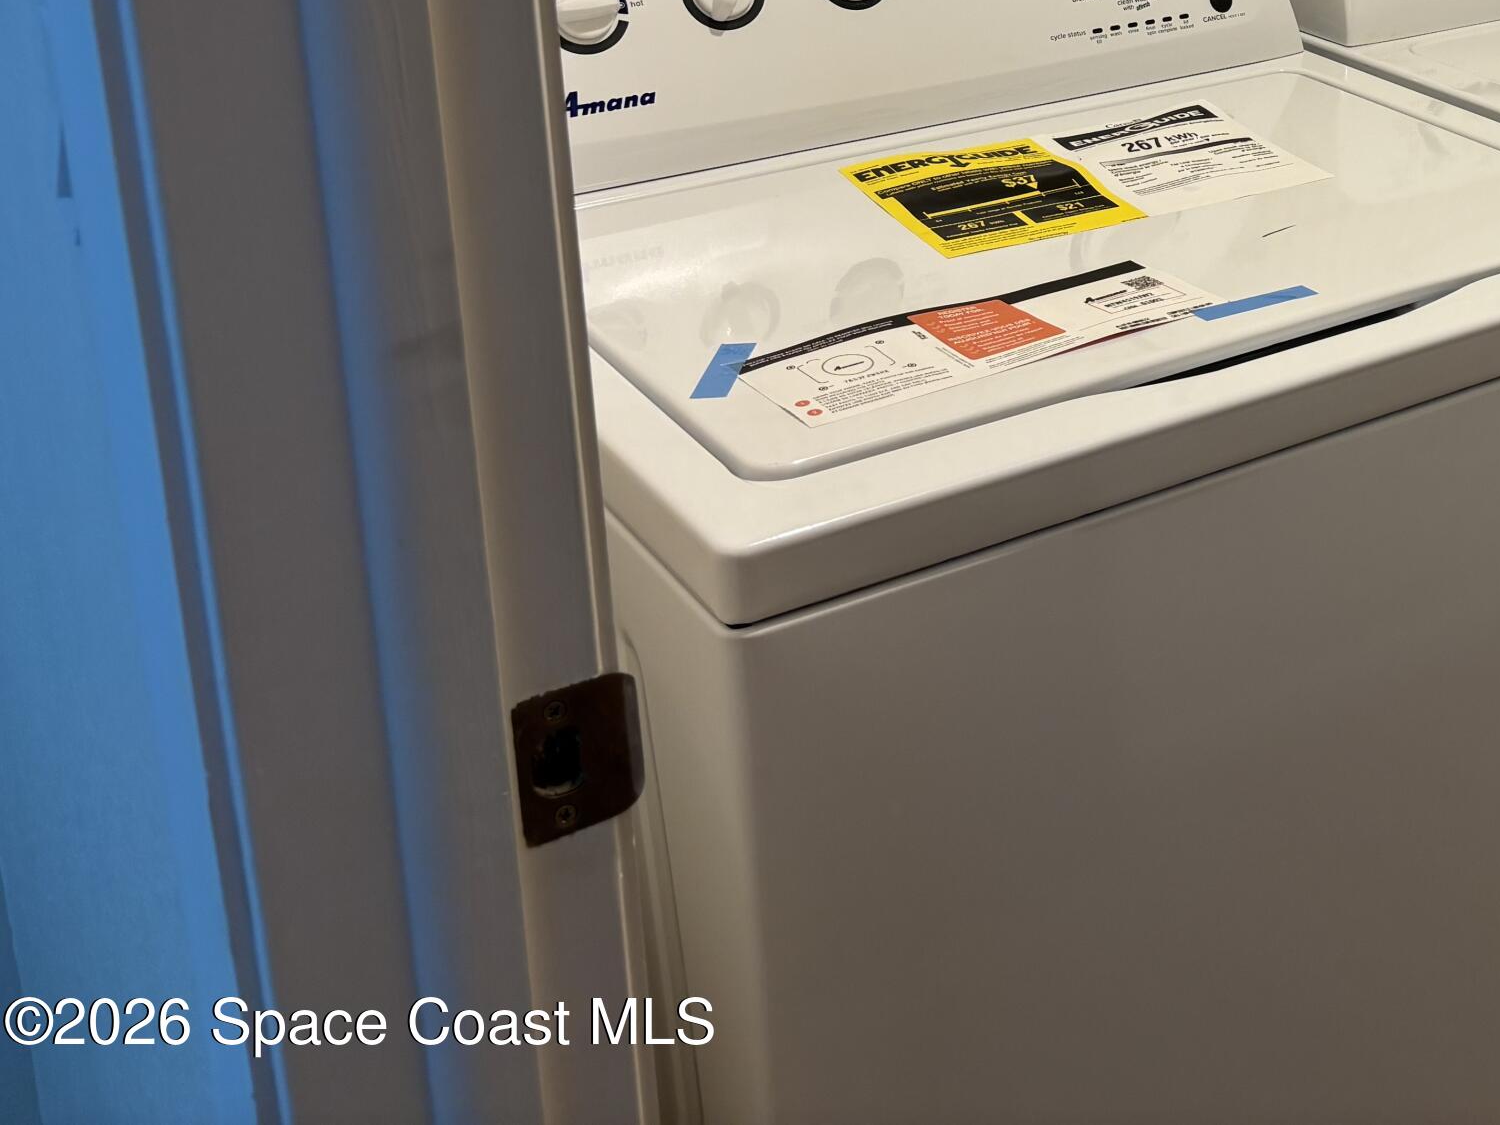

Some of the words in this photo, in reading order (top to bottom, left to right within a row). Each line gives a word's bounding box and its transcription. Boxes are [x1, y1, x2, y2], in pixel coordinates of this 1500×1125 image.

[1203, 14, 1227, 23] CANCEL
[1050, 32, 1066, 41] cycle
[1068, 30, 1086, 38] status
[566, 91, 656, 117] Amana
[1121, 137, 1162, 153] 267
[1164, 132, 1198, 142] kWh
[853, 145, 1038, 182] ENERGYGUIDE
[1002, 174, 1036, 188] $37
[1056, 202, 1084, 211] $21
[958, 220, 985, 231] 267
